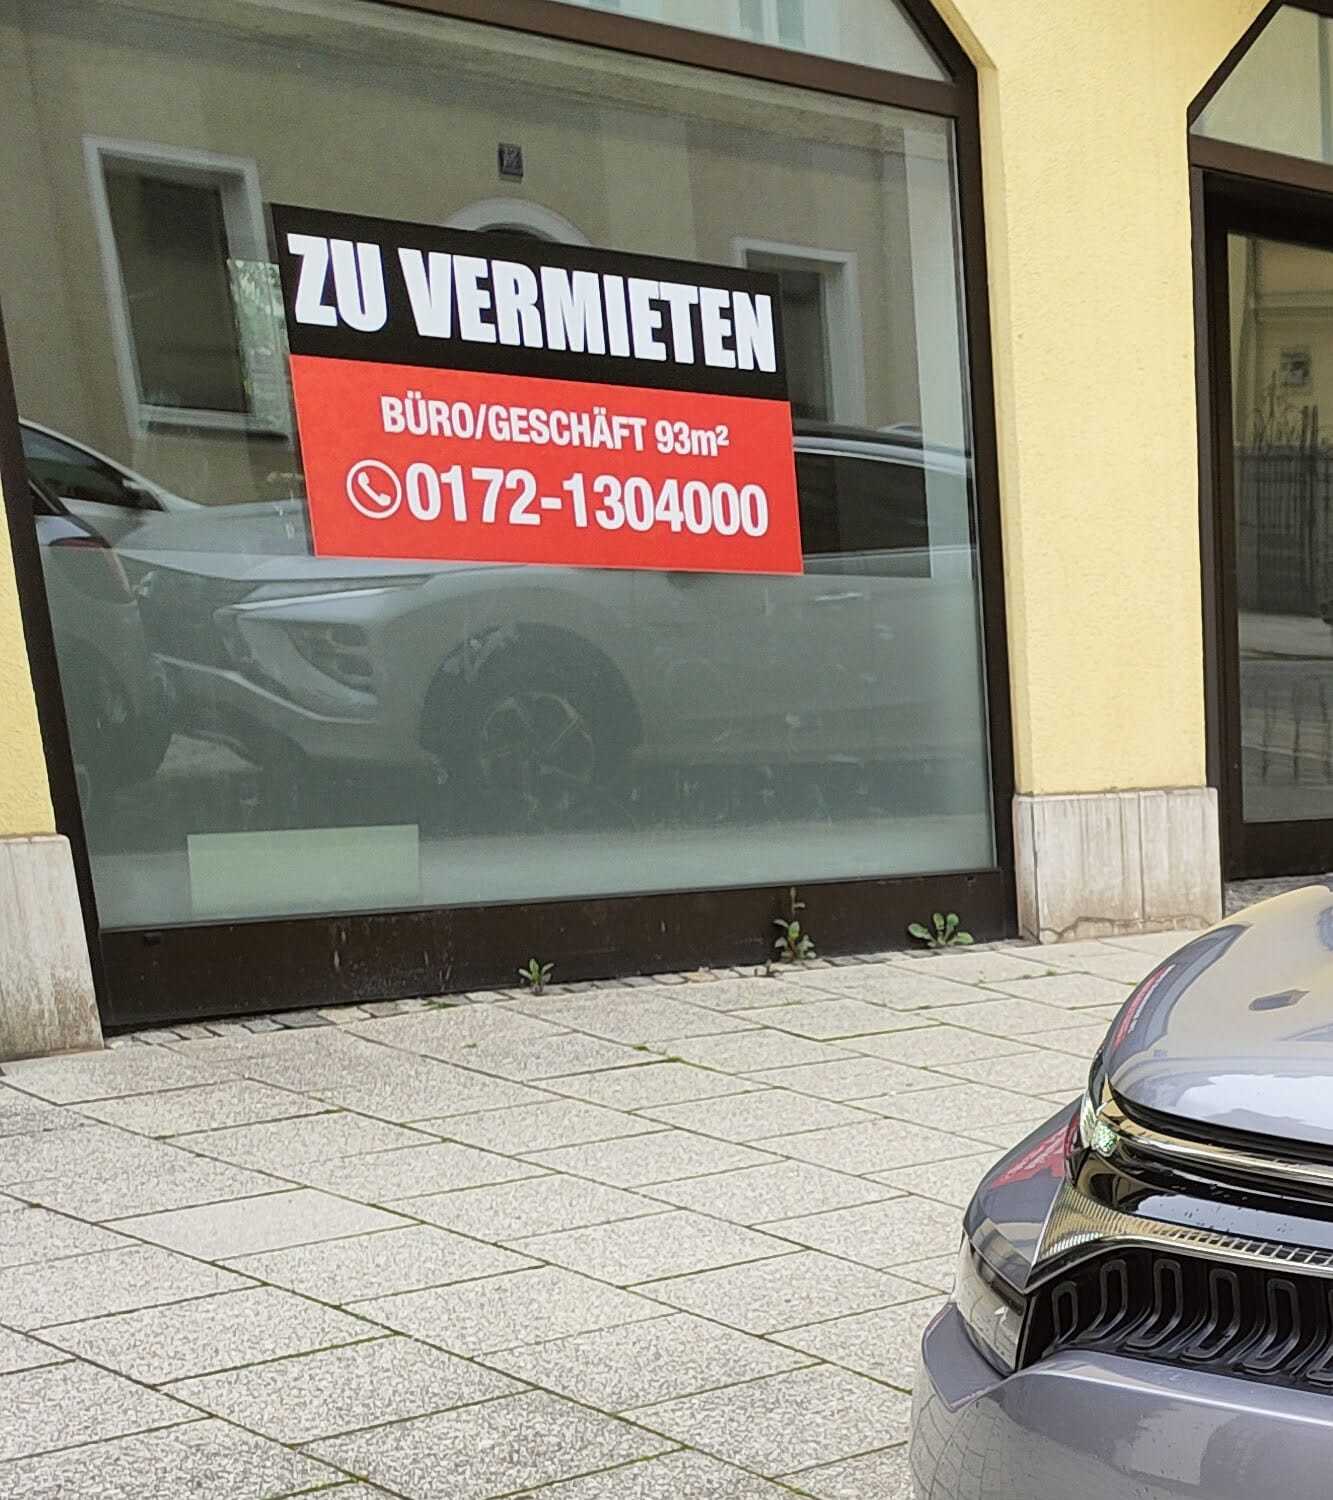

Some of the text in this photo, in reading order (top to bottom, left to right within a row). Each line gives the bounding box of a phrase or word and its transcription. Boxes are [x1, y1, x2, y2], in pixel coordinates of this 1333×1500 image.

[287, 233, 777, 374] ZU VERMIETEN
[381, 390, 647, 453] BÜRO/GESCHÄFT
[405, 461, 769, 538] 0172-1304000
